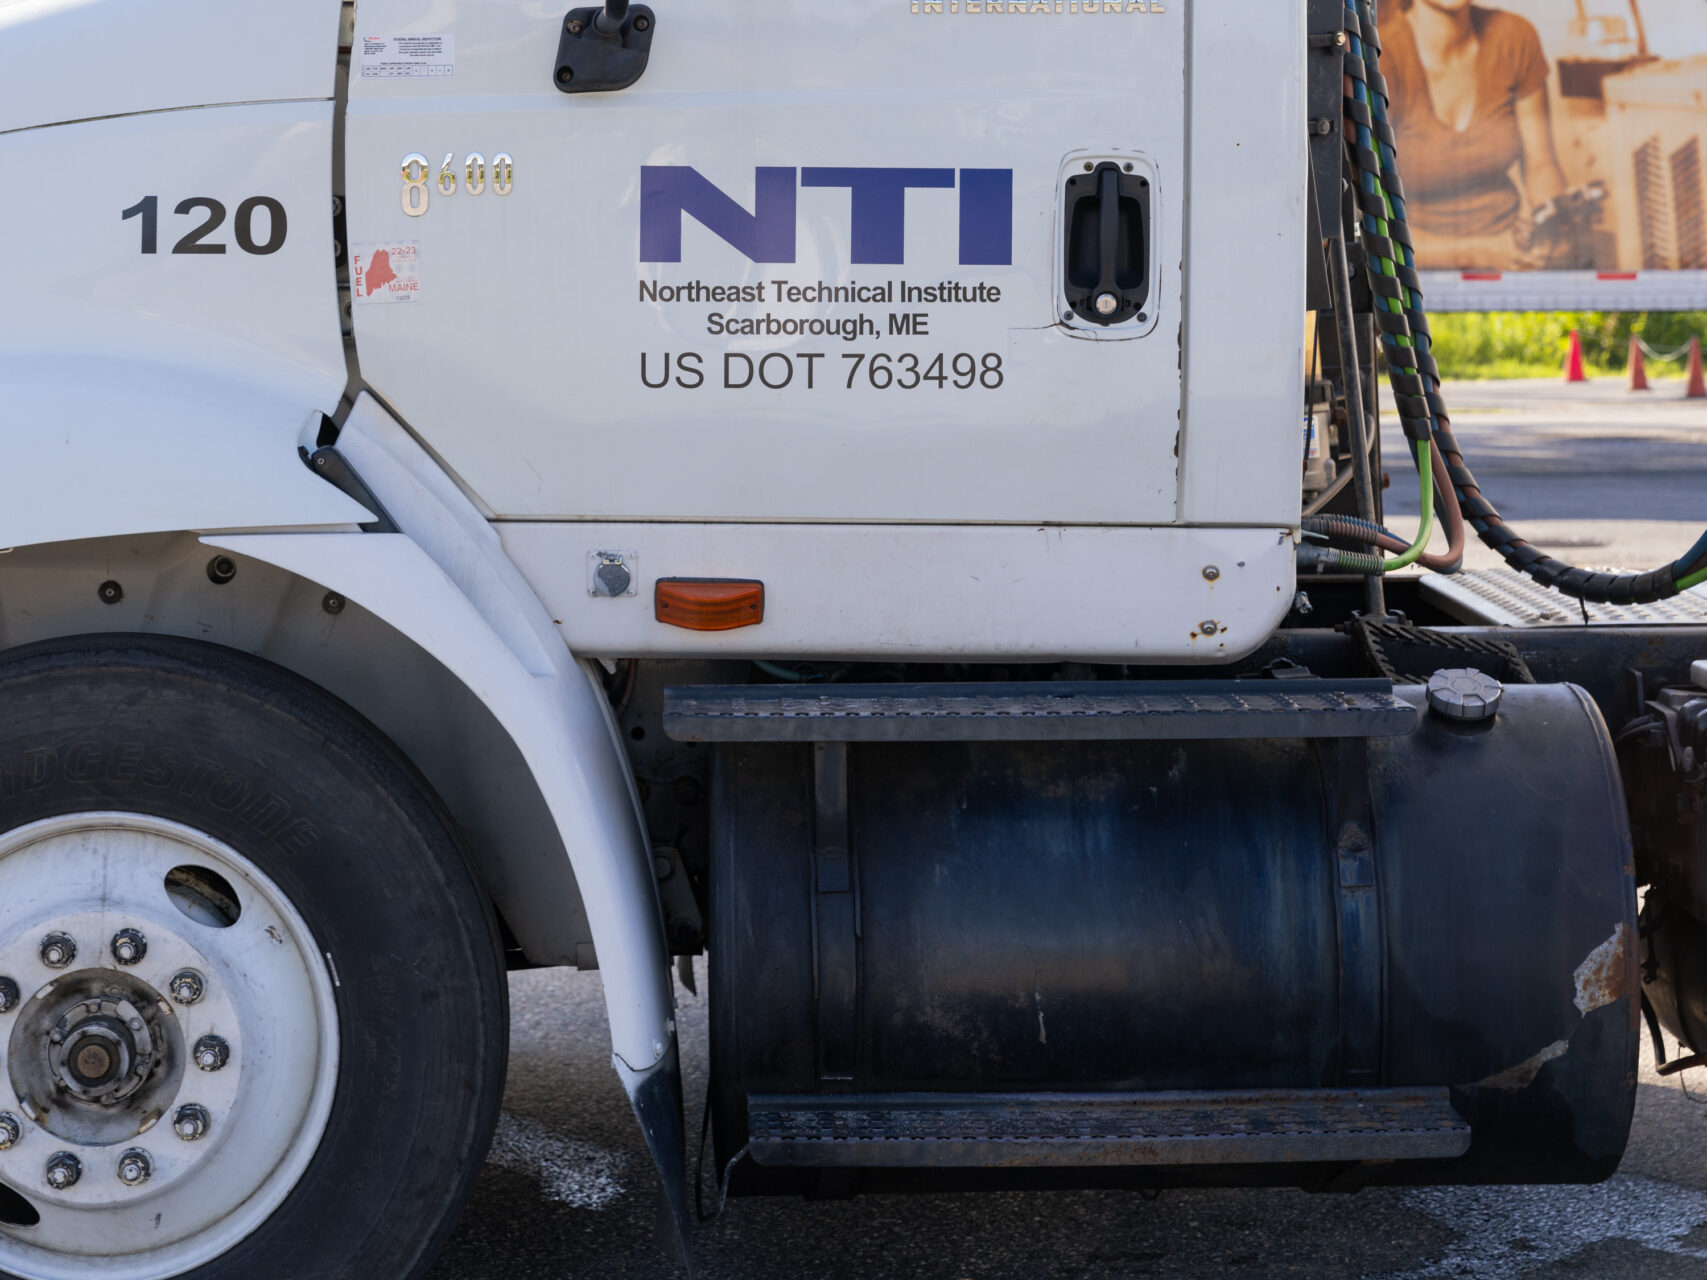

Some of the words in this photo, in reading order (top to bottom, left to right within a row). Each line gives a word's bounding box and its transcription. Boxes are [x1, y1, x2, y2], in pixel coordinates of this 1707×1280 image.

[401, 152, 513, 217] 8600
[121, 195, 288, 256] 120
[639, 165, 1013, 266] NTI
[391, 246, 417, 256] 22-23
[354, 255, 363, 298] FUEL
[388, 282, 420, 294] MAINE
[639, 279, 765, 303] Northeast
[771, 280, 893, 303] Technical
[900, 281, 1001, 303] Institute
[706, 312, 881, 342] Scarborough,
[888, 313, 930, 336] ME
[640, 352, 705, 389] US
[723, 352, 825, 389] DOT
[841, 352, 1005, 390] 763498
